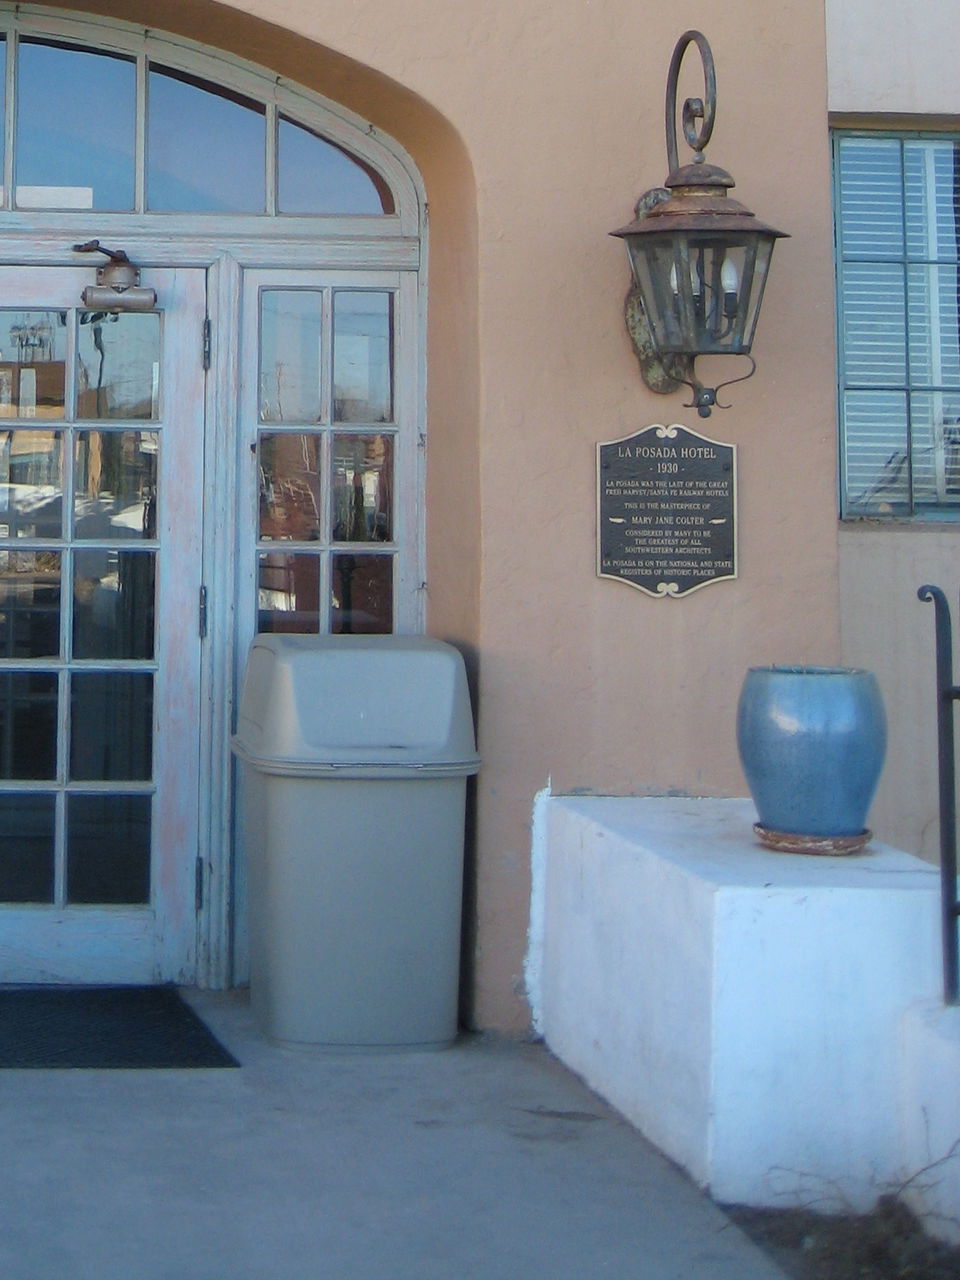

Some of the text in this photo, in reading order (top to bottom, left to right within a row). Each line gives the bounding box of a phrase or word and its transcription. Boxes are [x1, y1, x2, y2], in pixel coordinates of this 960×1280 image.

[618, 447, 717, 459] LA POSADA HOTEL
[657, 463, 678, 473] 1930
[640, 480, 654, 488] WAS
[655, 480, 667, 488] THE
[669, 480, 683, 488] LAST
[631, 516, 705, 525] MARY JANE COLTER
[668, 560, 699, 568] NATIONAL
[700, 560, 713, 568] AND
[714, 560, 732, 568] STATE
